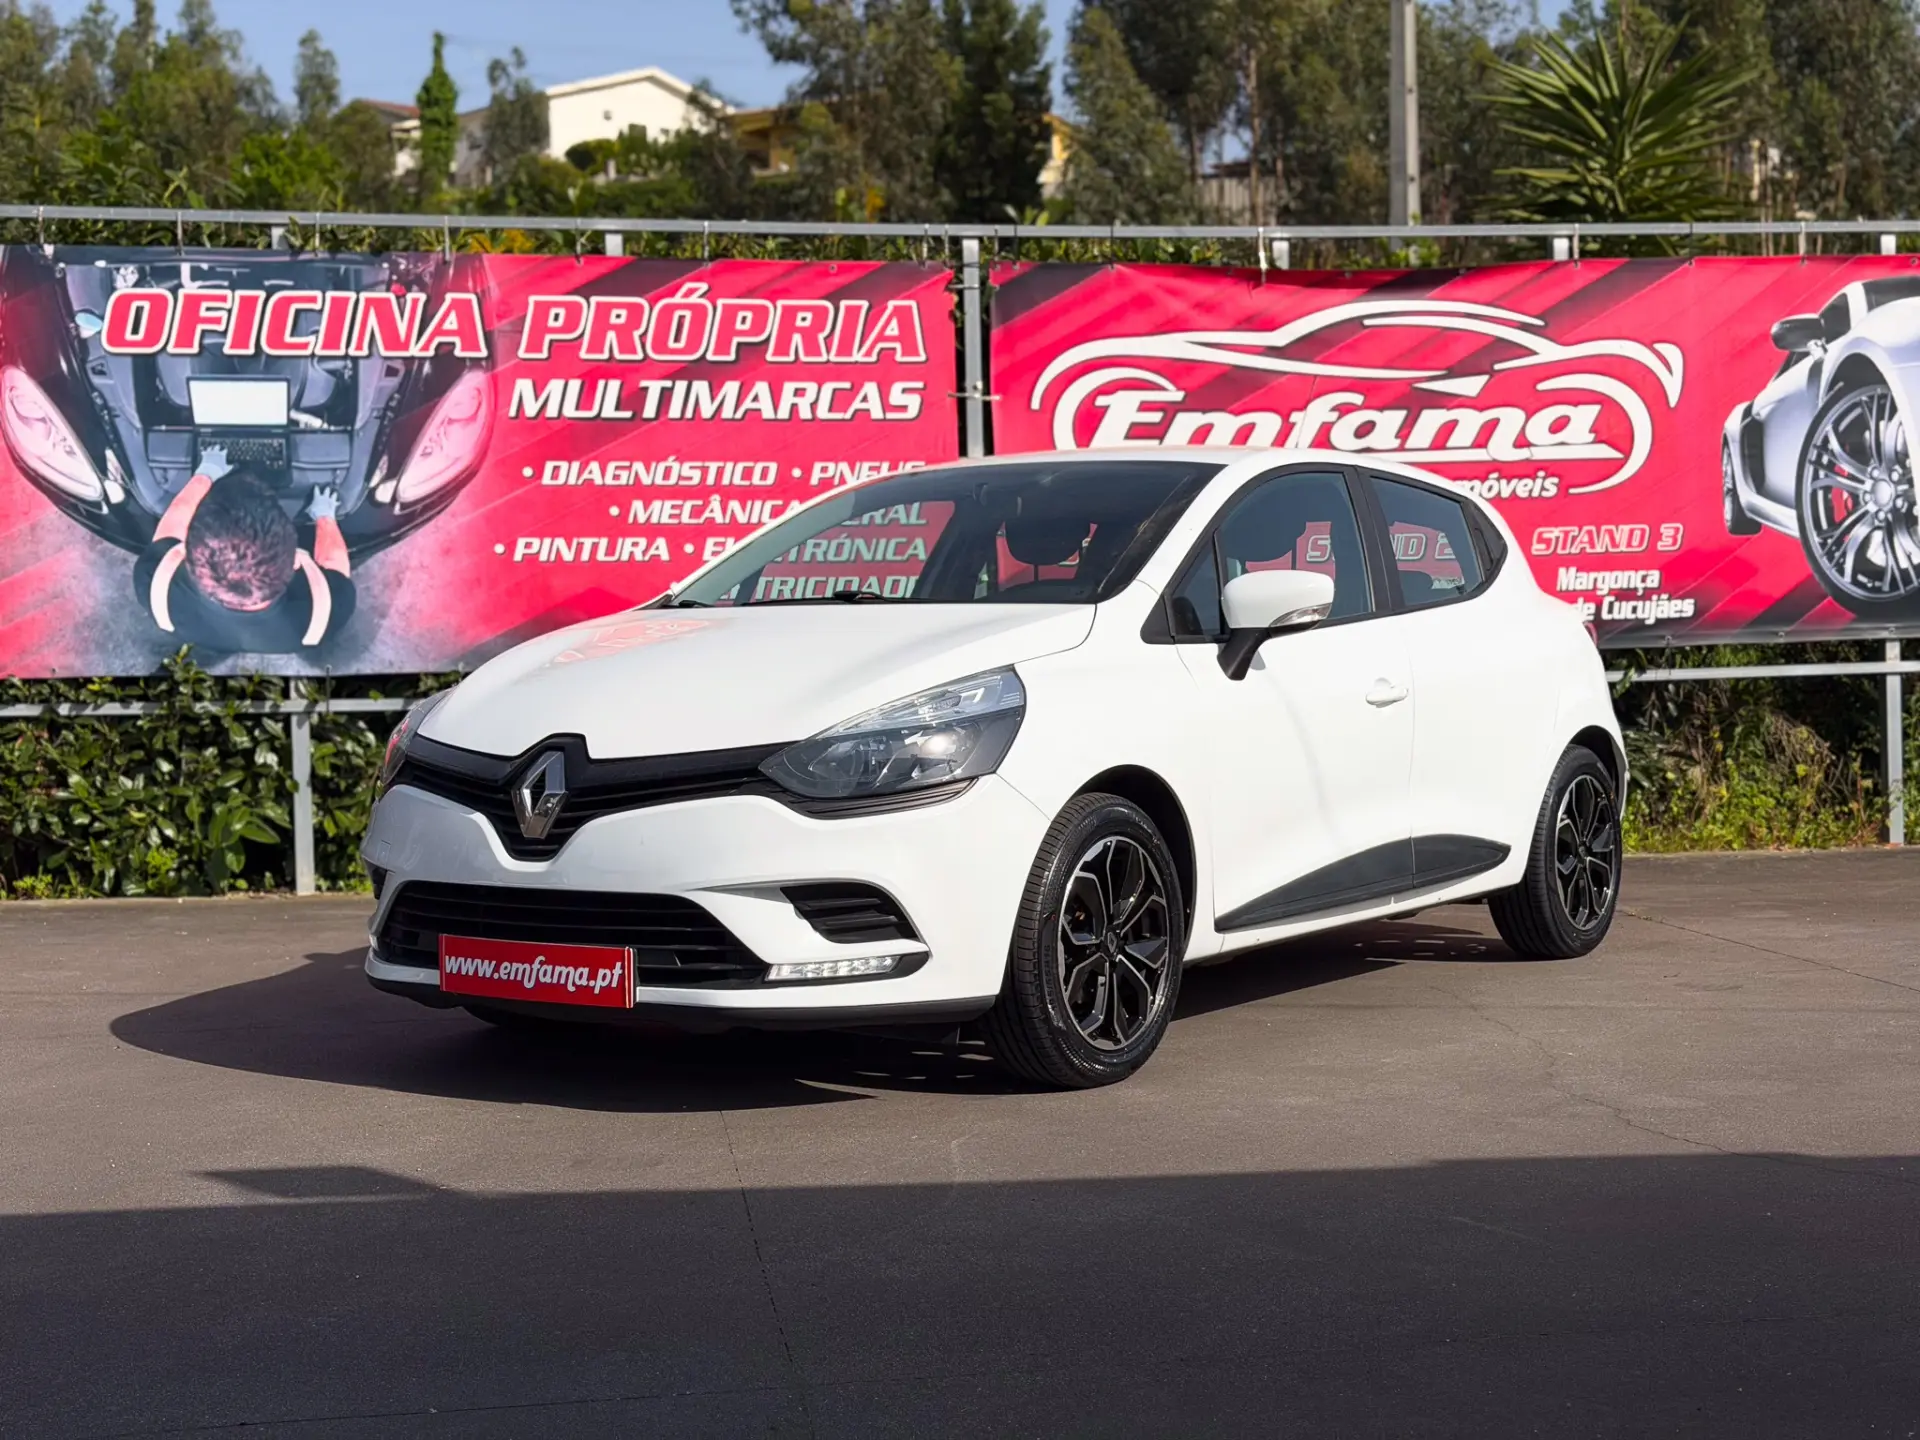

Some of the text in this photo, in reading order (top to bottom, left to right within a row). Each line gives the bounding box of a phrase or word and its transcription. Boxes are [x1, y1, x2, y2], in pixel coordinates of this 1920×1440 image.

[101, 282, 927, 364] OFICINA PRÓPRIA
[508, 378, 927, 421] MULTIMARCAS
[1087, 391, 1603, 460] Emfama
[541, 455, 778, 487] DIAGNÓSTICO
[512, 536, 671, 563] PINTURA
[1531, 522, 1684, 556] STAND 3
[1556, 566, 1661, 596] Margonça
[1601, 594, 1695, 625] Cucujães
[444, 955, 624, 995] www.emfama.pt
